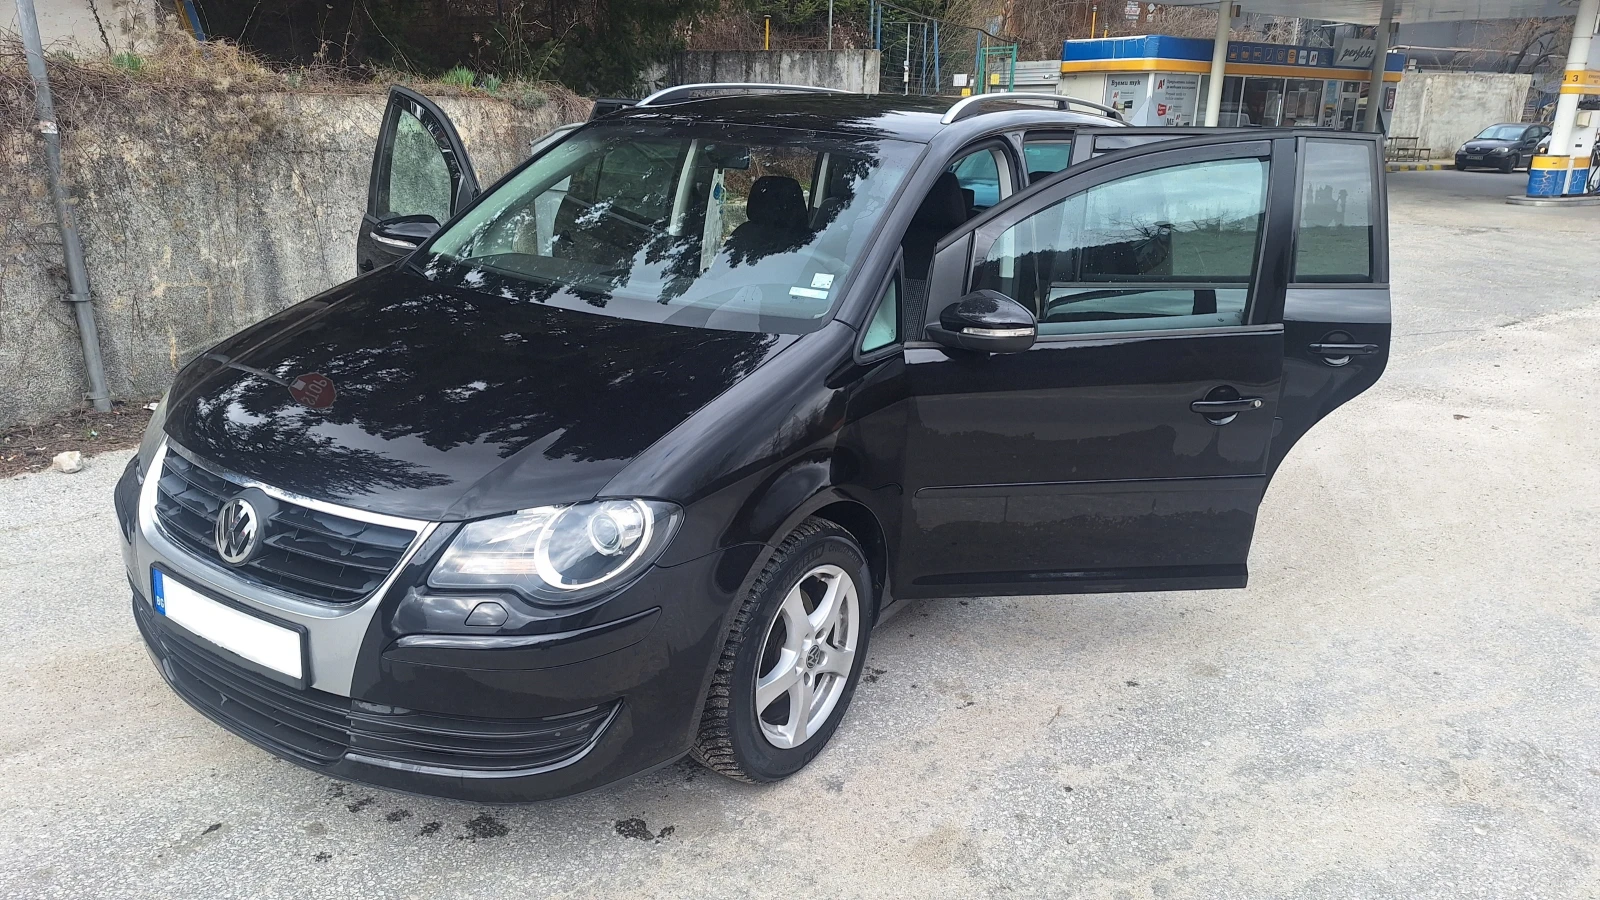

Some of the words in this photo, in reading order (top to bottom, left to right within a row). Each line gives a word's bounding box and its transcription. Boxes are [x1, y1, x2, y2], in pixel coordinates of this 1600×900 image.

[1341, 45, 1375, 61] perfekt
[1572, 74, 1579, 82] 3
[156, 596, 165, 609] BG
